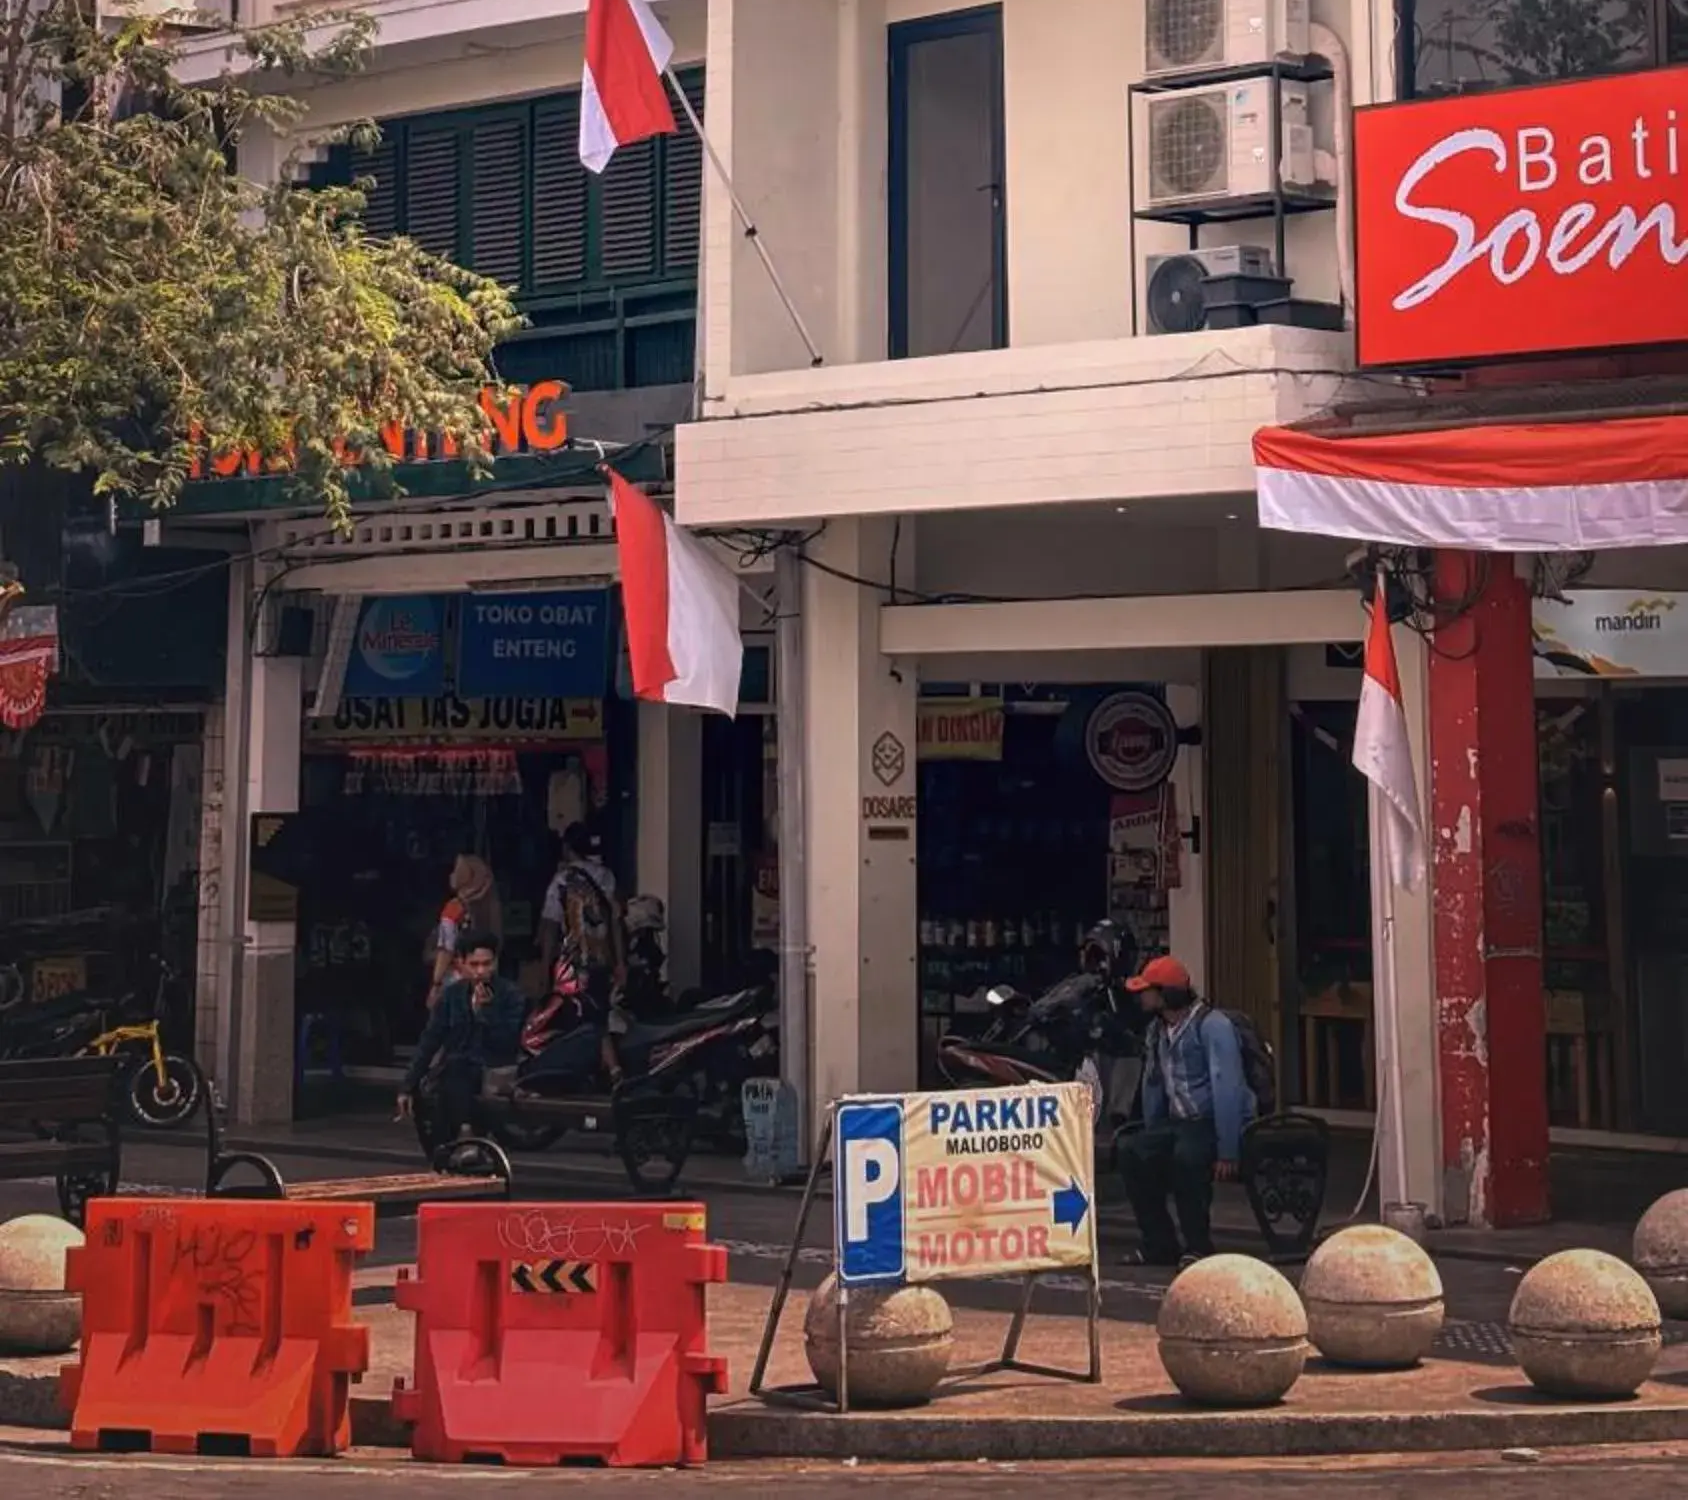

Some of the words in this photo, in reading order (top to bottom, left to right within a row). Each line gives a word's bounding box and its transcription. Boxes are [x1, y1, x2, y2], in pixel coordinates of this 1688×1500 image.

[475, 605, 532, 625] TOKO
[540, 605, 597, 625] OBAT
[1595, 612, 1661, 631] mandiri
[493, 639, 576, 658] ENTENG
[863, 796, 916, 819] DOSARE
[930, 1095, 1060, 1135] PARKIR
[946, 1133, 1044, 1156] MALIOBORO
[846, 1138, 899, 1242] P
[916, 1160, 1047, 1208] MOBIL
[918, 1225, 1050, 1268] MOTOR
